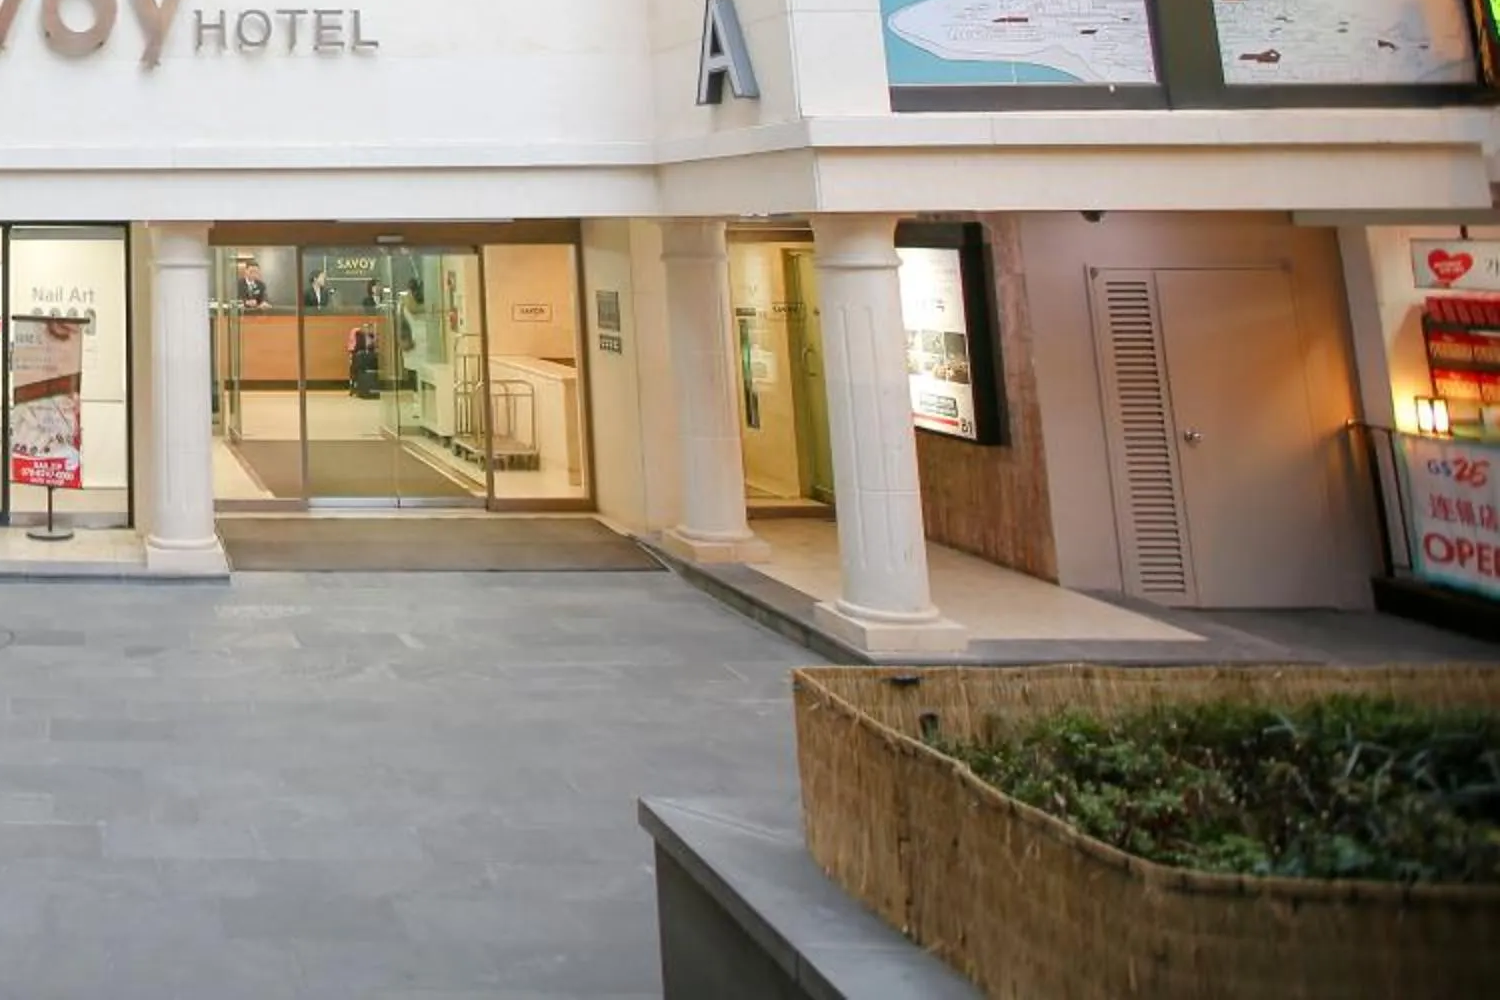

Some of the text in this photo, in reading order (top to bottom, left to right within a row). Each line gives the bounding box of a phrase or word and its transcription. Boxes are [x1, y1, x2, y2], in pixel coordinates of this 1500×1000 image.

[193, 8, 380, 56] HOTEL
[336, 257, 377, 271] SAVOY
[31, 286, 96, 302] Nail Art
